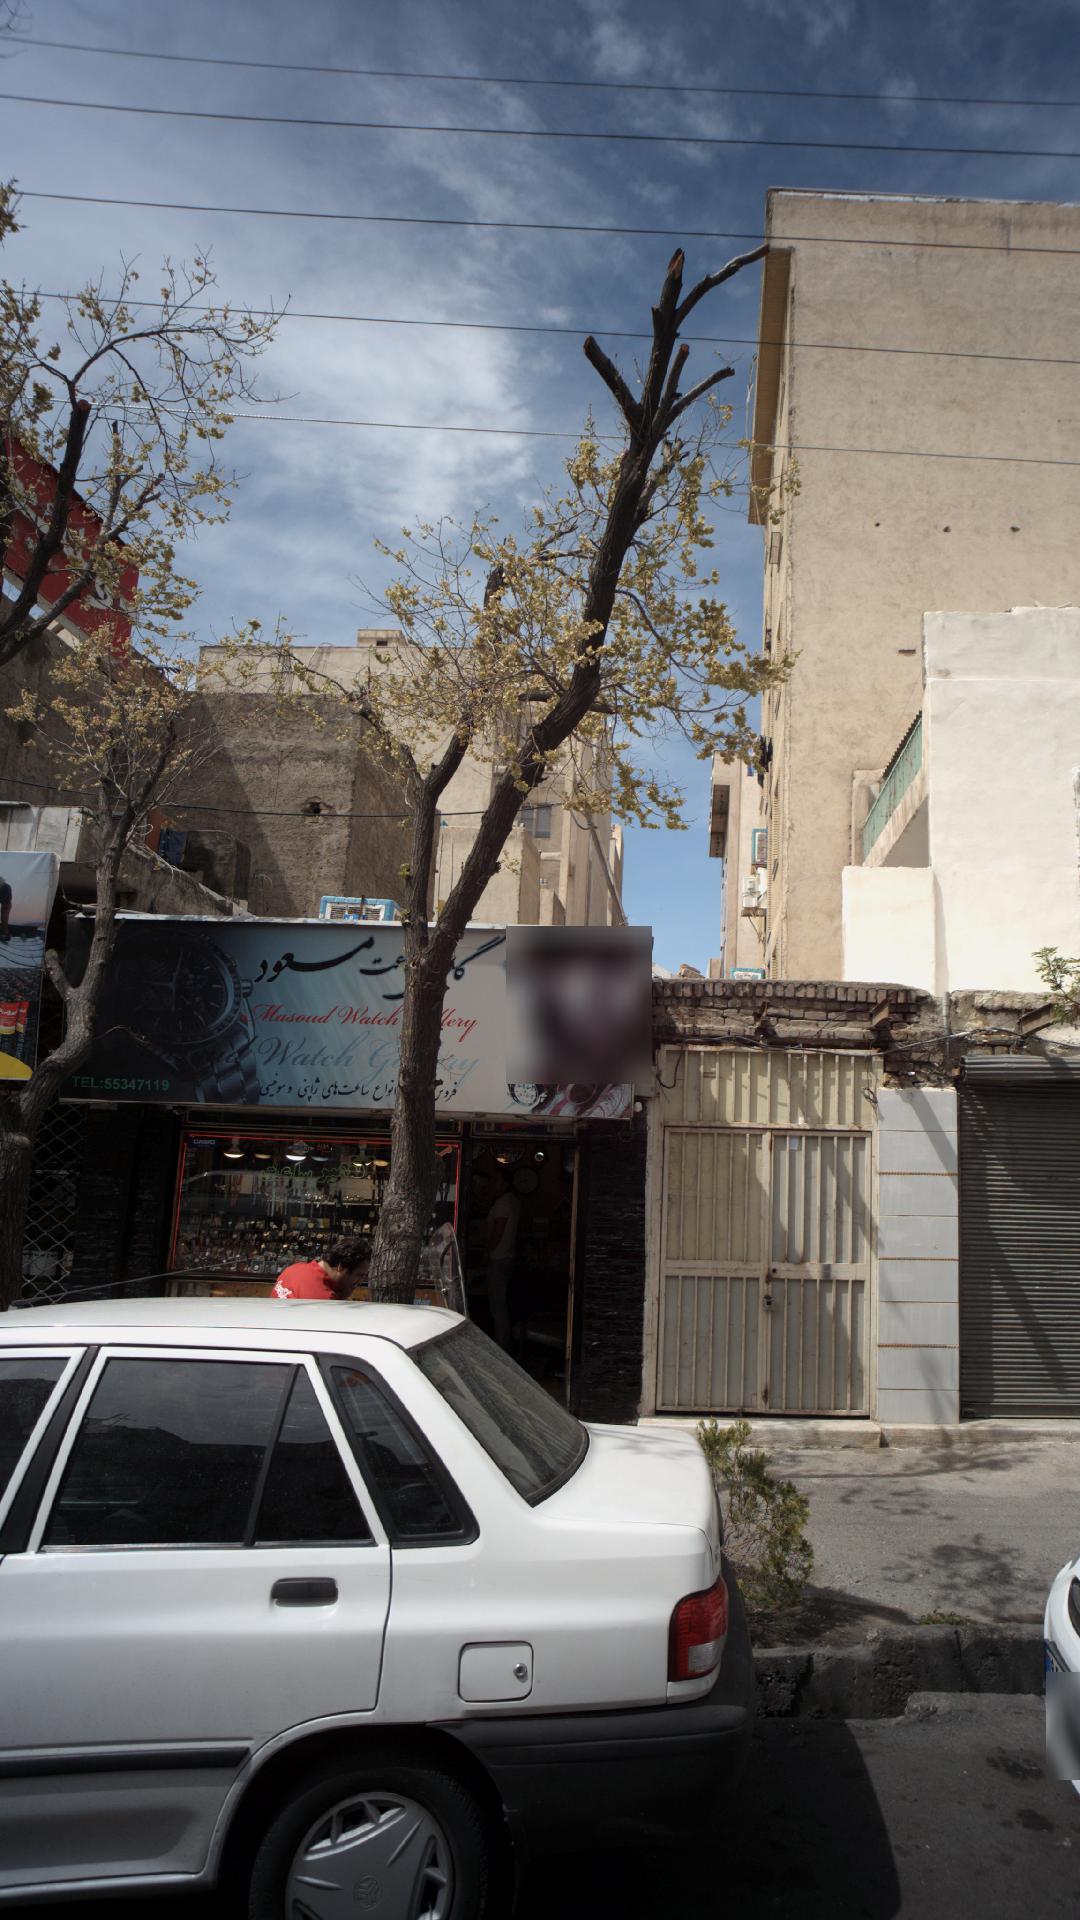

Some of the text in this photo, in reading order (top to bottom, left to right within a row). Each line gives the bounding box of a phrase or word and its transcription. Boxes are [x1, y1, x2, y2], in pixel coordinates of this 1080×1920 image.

[254, 936, 375, 983] مسعود
[243, 1003, 337, 1025] Masoud
[338, 1004, 404, 1026] Watch
[258, 1031, 369, 1067] Watch
